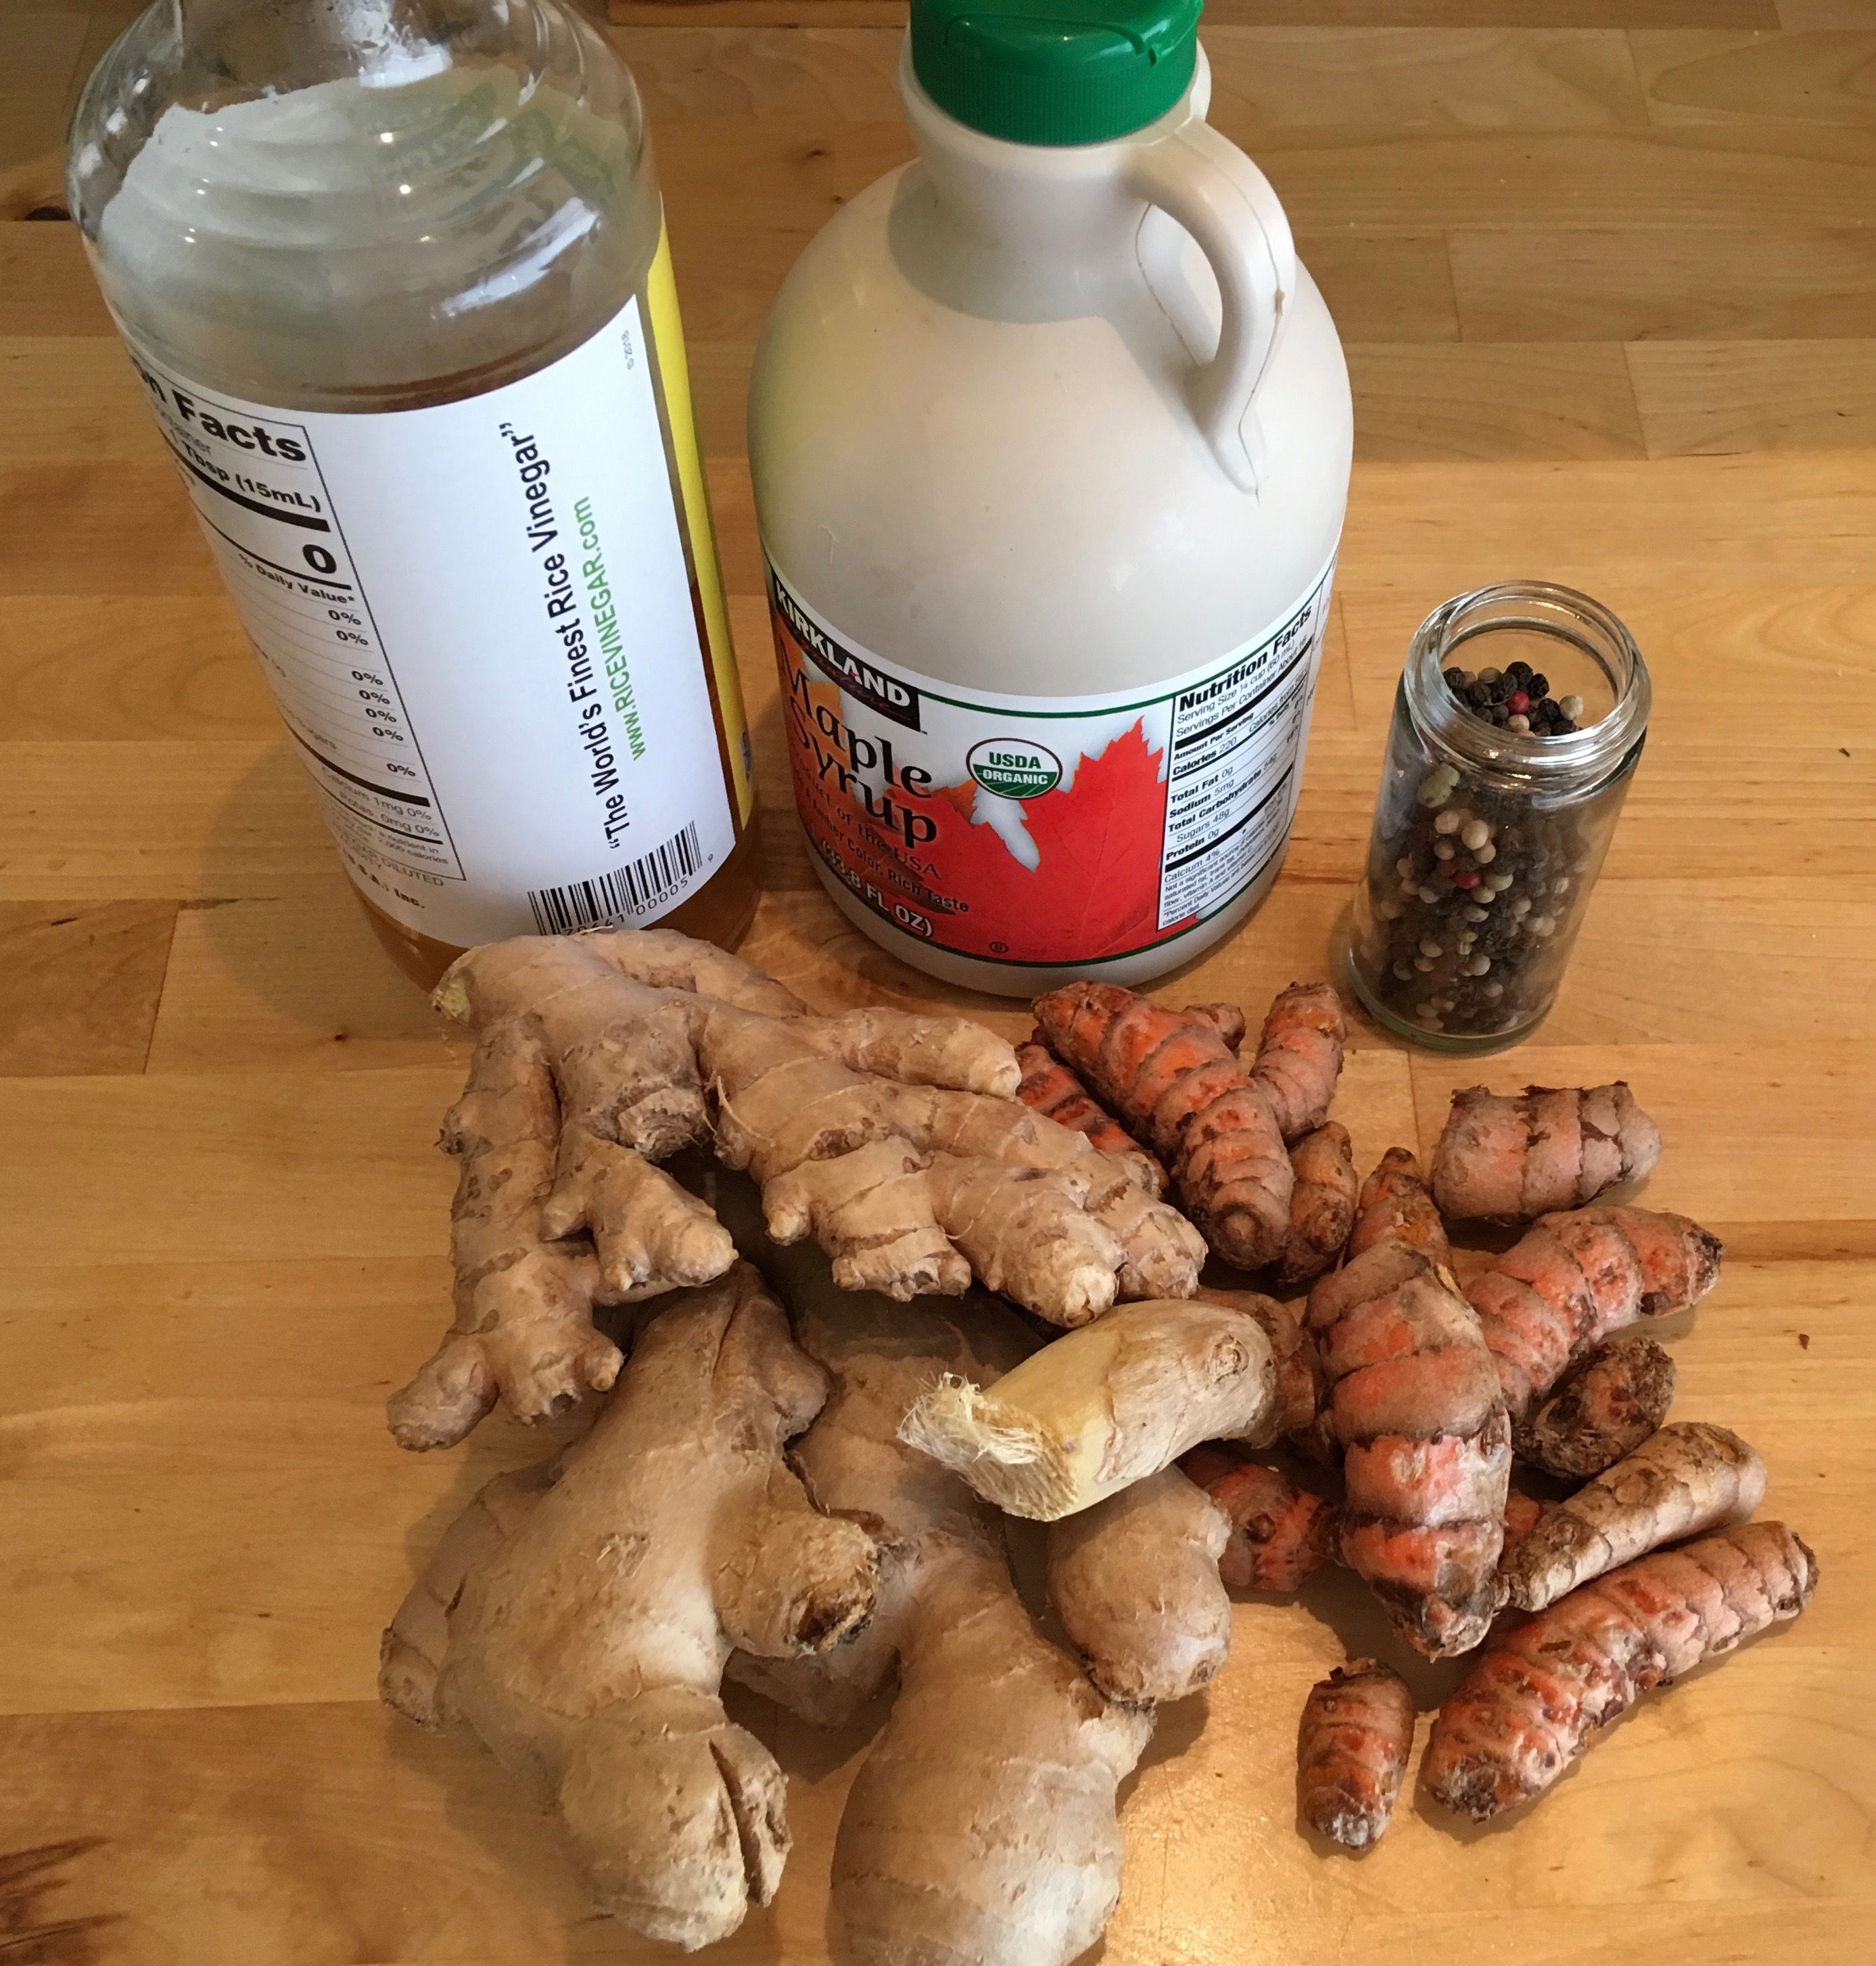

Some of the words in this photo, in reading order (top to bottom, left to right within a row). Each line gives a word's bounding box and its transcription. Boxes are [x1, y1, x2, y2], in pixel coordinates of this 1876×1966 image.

[172, 389, 306, 461] Facts
[182, 440, 231, 482] Tbsp
[235, 474, 321, 513] (15mL)
[256, 563, 293, 590] Daily
[302, 544, 337, 574] 0
[544, 553, 576, 619] Rice
[328, 610, 362, 625] 0%
[573, 496, 646, 761] www.RICEVINEGAR.com
[336, 630, 369, 645] 0%
[776, 580, 911, 707] KIRKLAND
[555, 617, 597, 703] Finest
[1179, 651, 1268, 712] Nutrition
[1273, 605, 1312, 656] Facts
[351, 670, 383, 685] 0%
[359, 689, 390, 704] 0%
[365, 707, 397, 722] 0%
[1176, 712, 1219, 738] Servings
[1221, 702, 1238, 716] Per
[1239, 670, 1277, 705] Container
[1177, 702, 1215, 724] Serving
[1218, 689, 1237, 706] Size
[1250, 670, 1266, 686] cup
[373, 726, 404, 741] 0%
[780, 637, 932, 799] Maple
[1174, 741, 1208, 761] Amount
[1210, 731, 1224, 744] Per
[1225, 712, 1254, 735] Serving
[578, 703, 619, 796] World's
[989, 751, 1041, 769] USDA
[1173, 750, 1217, 776] Calories
[1219, 736, 1237, 754] 220
[386, 763, 416, 777] 0%
[789, 696, 937, 849] Syrup
[982, 769, 1048, 785] ORGANIC
[1170, 785, 1199, 803] Total
[1202, 774, 1219, 790] Fat
[1221, 766, 1234, 778] 0g
[407, 808, 432, 820] 0%
[1168, 814, 1196, 833] Total
[1199, 769, 1262, 818] Carbohydrate
[1169, 793, 1211, 818] Sodium
[1214, 779, 1234, 796] 5mg
[381, 814, 411, 832] 0mg
[415, 824, 440, 837] 0%
[1176, 820, 1211, 843] Sugars
[1212, 808, 1230, 823] 48g
[858, 823, 889, 852] the
[893, 847, 942, 880] USA
[1166, 837, 1205, 861] Protein
[1207, 828, 1220, 840] 0g
[1165, 860, 1203, 883] Calcium
[1165, 883, 1178, 893] Not
[1185, 860, 1218, 885] significant
[1183, 881, 1208, 899] vitamin
[635, 876, 688, 916] 00005
[888, 868, 921, 895] Rich
[927, 889, 969, 913] Taste
[1165, 882, 1197, 901] saturated
[1194, 891, 1210, 904] Daily
[866, 882, 891, 913] FL
[894, 904, 933, 937] OZ)
